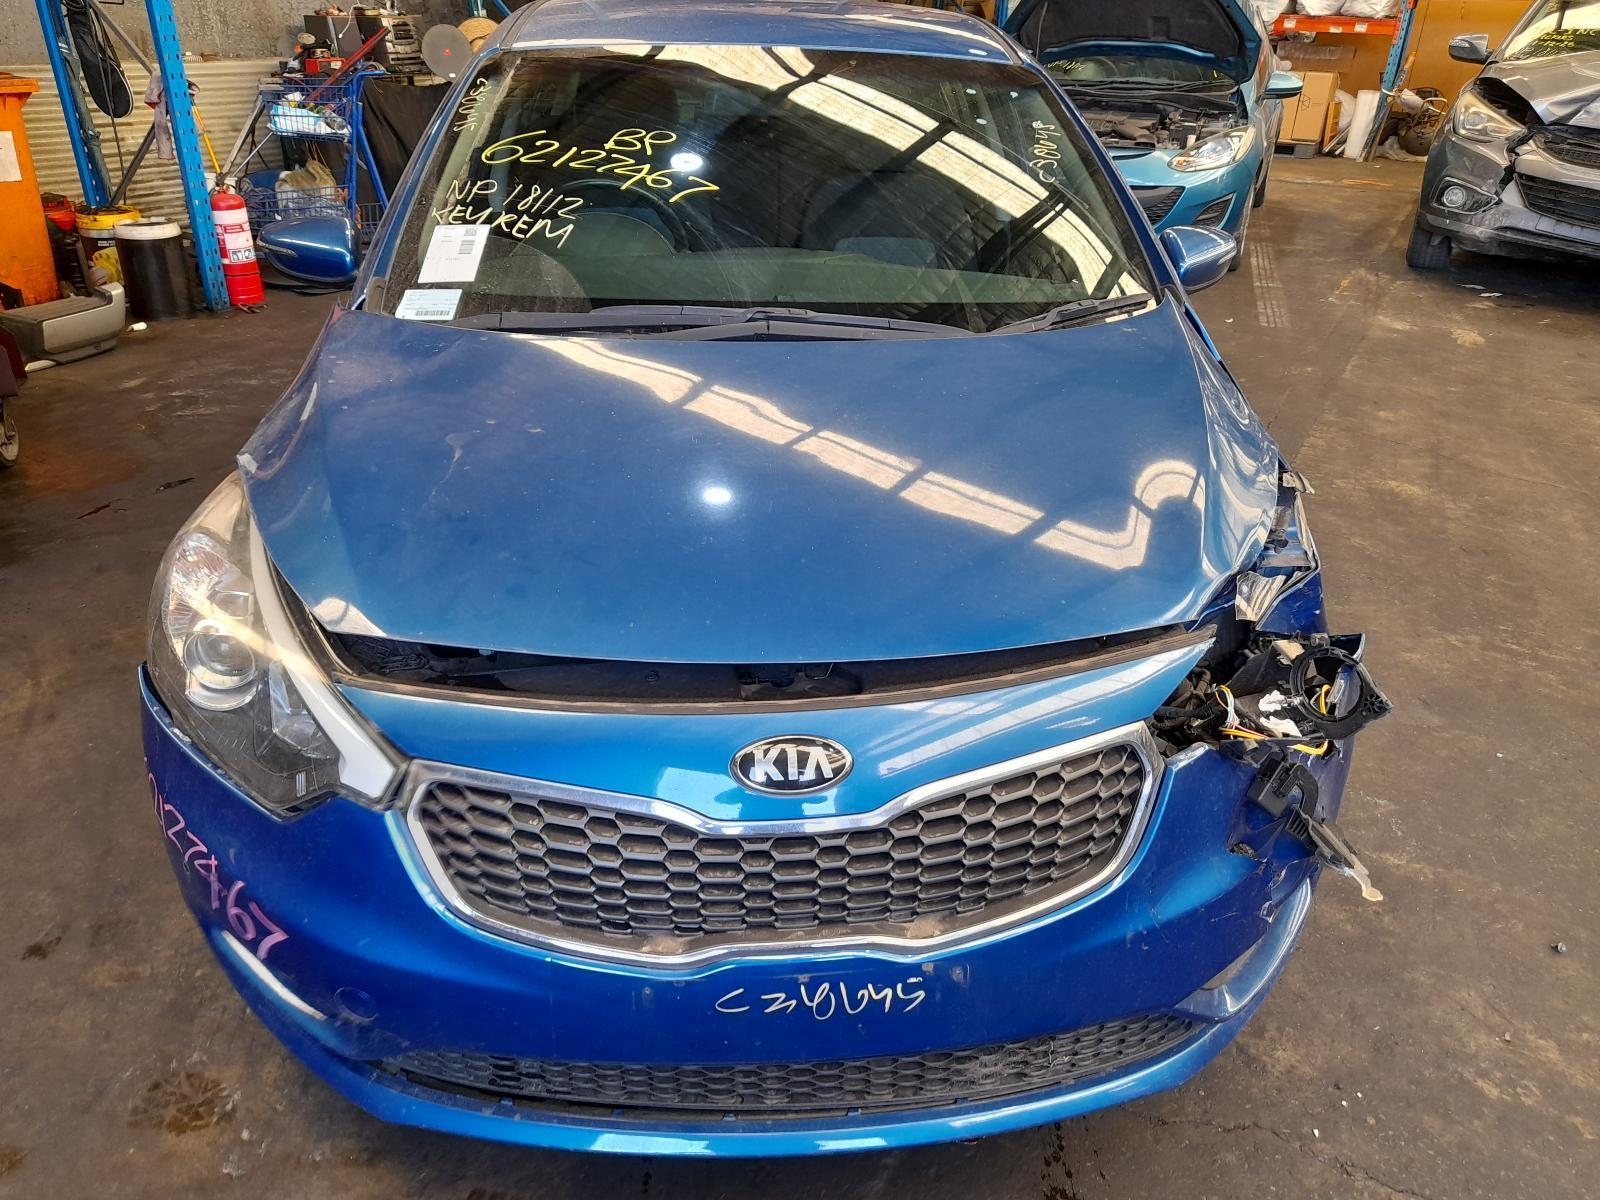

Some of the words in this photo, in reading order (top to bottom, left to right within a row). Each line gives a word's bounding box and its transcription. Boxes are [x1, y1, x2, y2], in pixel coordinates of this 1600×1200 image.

[604, 127, 677, 156] BP
[446, 179, 497, 203] NP
[431, 203, 493, 226] KEY
[491, 210, 575, 248] REM
[751, 746, 834, 781] KIA
